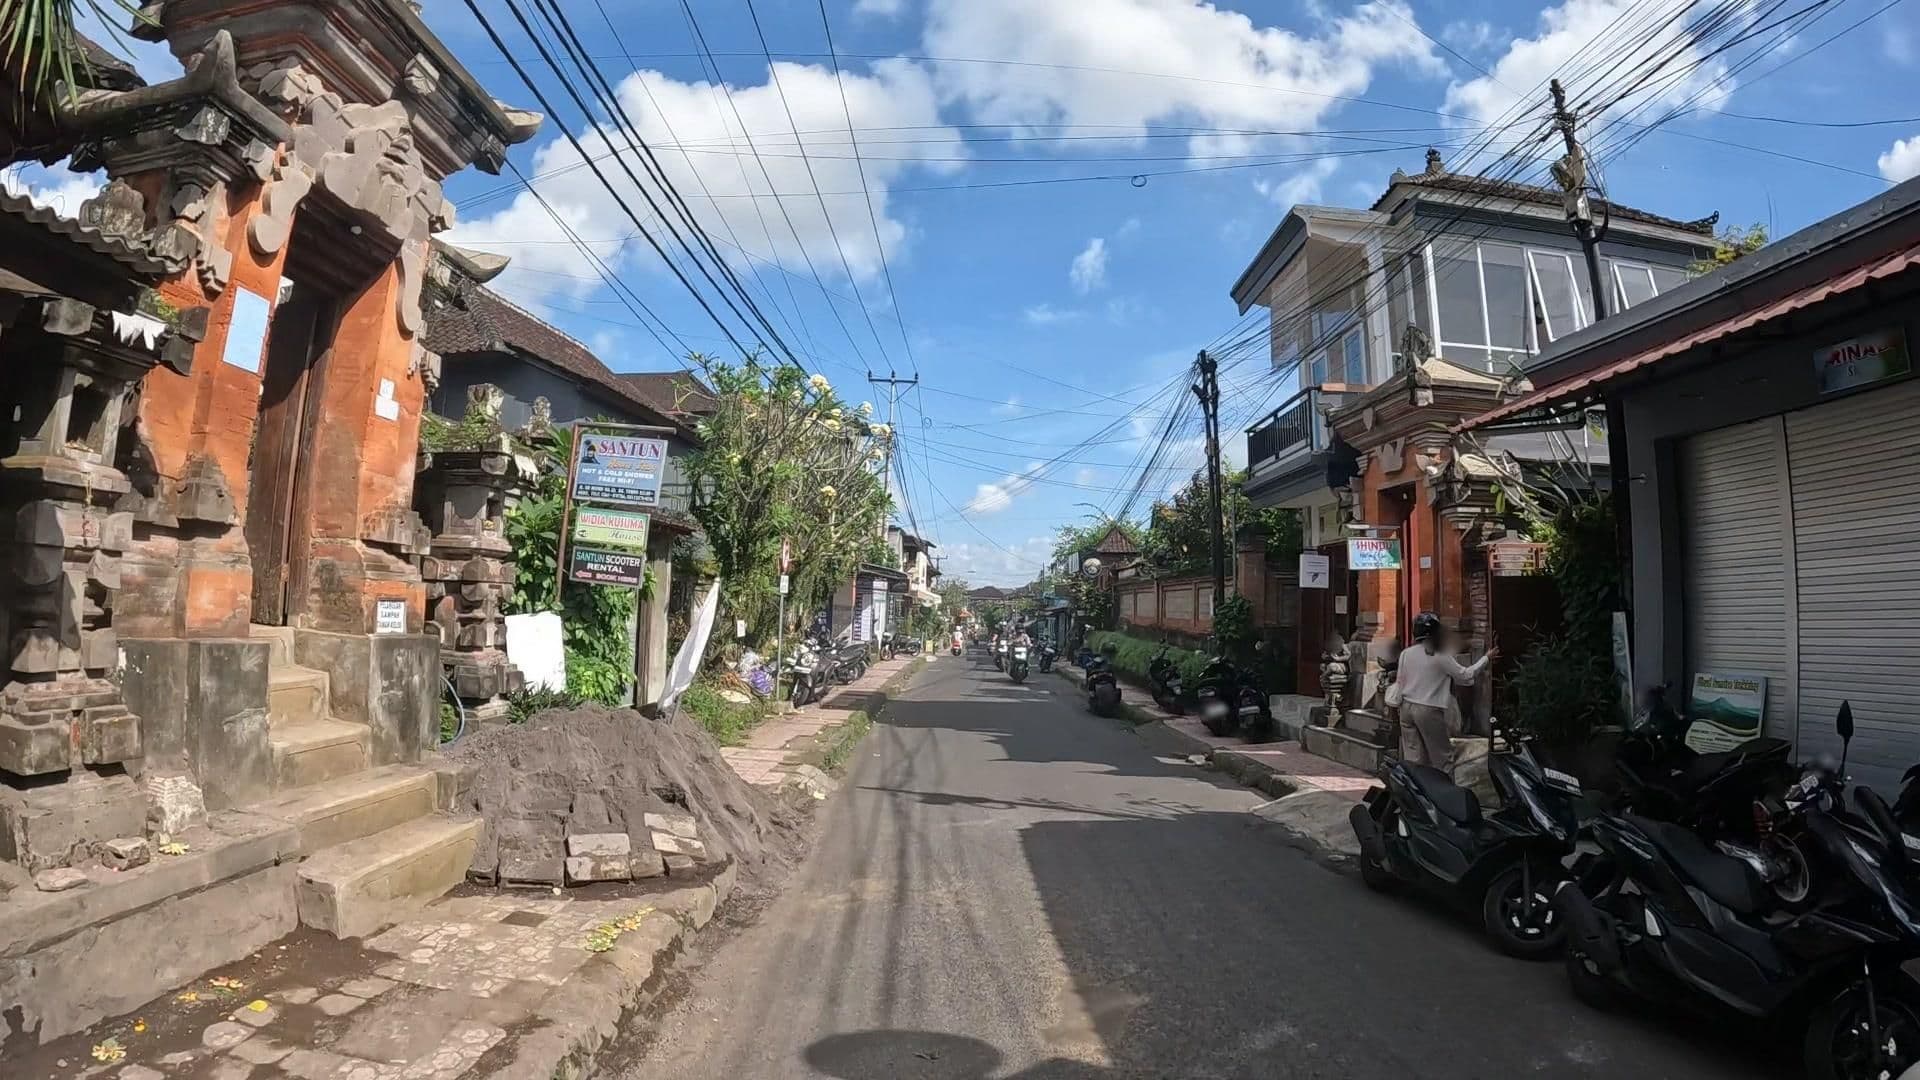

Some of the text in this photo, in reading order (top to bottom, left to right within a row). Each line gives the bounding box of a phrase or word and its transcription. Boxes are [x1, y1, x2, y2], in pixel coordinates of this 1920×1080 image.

[599, 439, 661, 459] SANTUN
[603, 469, 623, 477] COLD
[624, 471, 654, 479] SHOWER
[580, 512, 644, 530] WIDIA KUSUMA
[610, 529, 642, 542] House
[575, 551, 641, 567] SANTUN SCOOTER
[586, 563, 625, 574] RENTAL
[595, 573, 617, 581] BOOK
